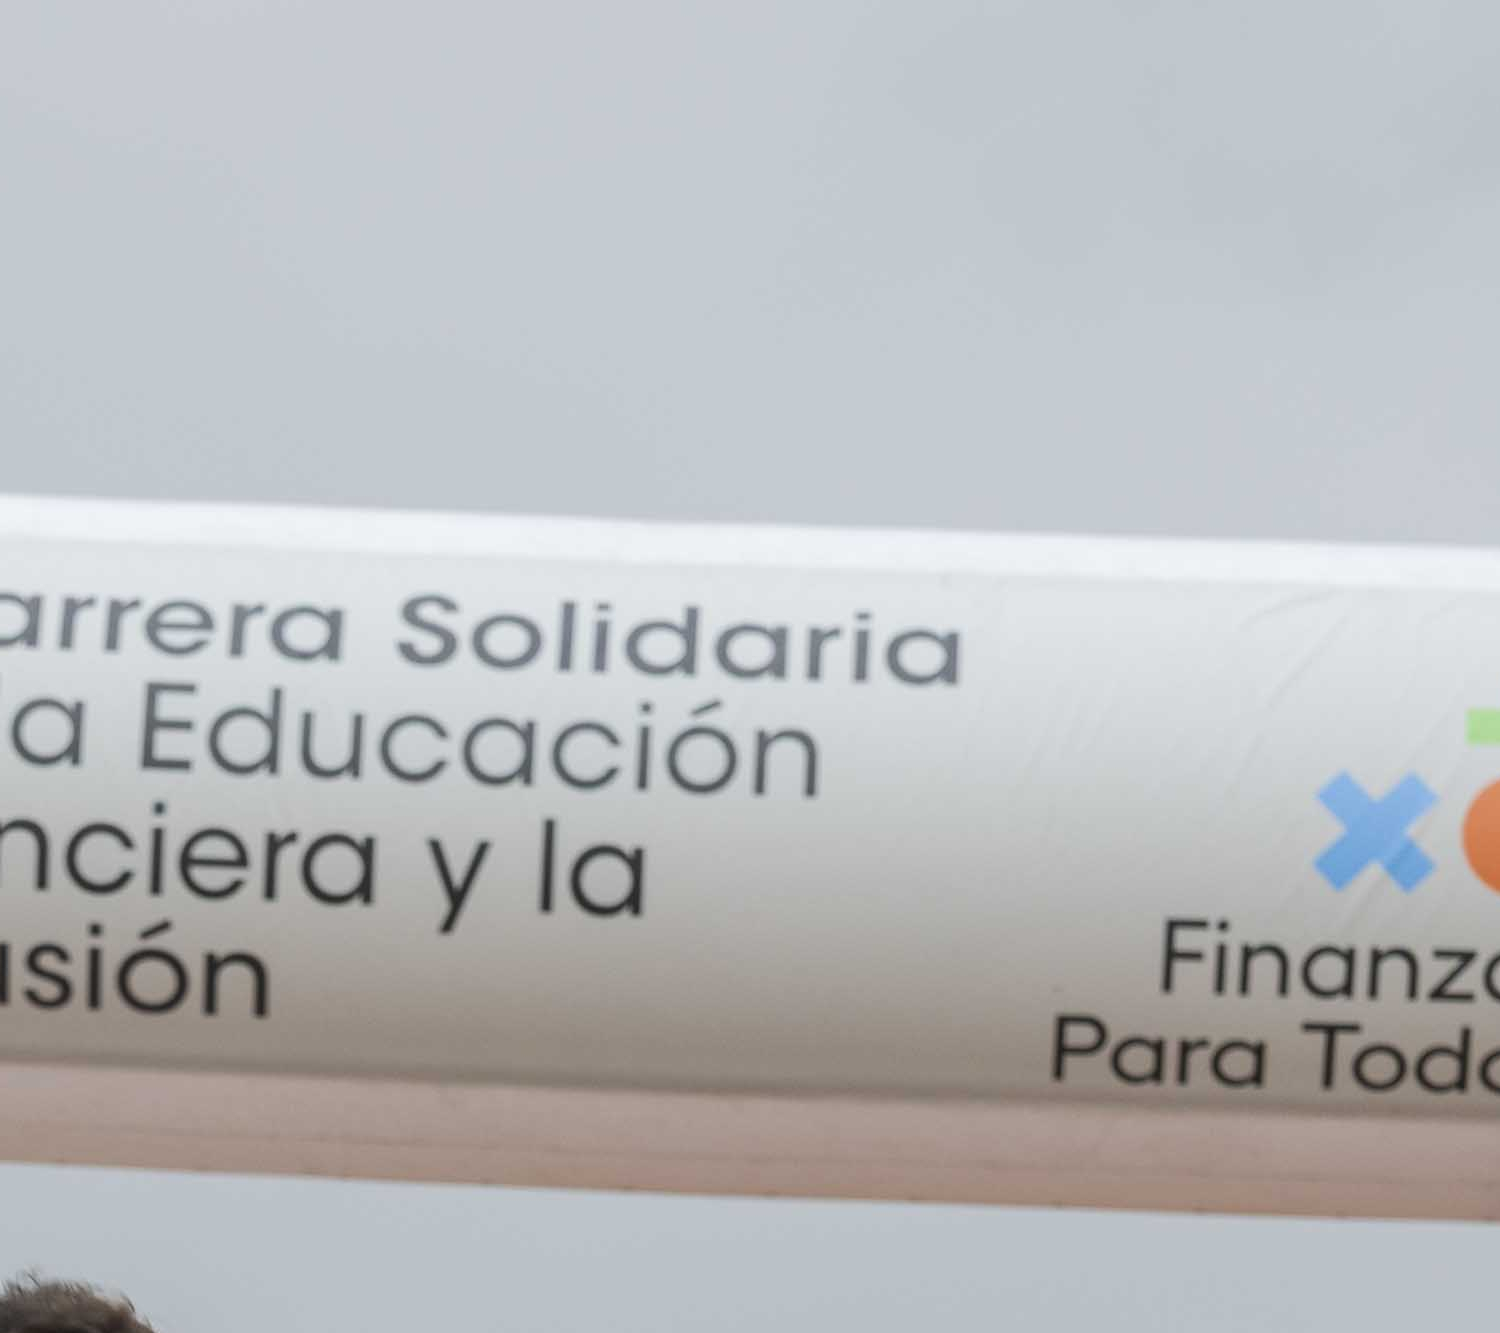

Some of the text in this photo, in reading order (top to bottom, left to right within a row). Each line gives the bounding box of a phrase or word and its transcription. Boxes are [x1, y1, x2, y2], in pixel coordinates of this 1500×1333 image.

[395, 593, 961, 686] Solidaria
[140, 681, 819, 799] Educación
[426, 838, 491, 936] y
[538, 819, 646, 918] la
[1050, 1012, 1268, 1089] Para
